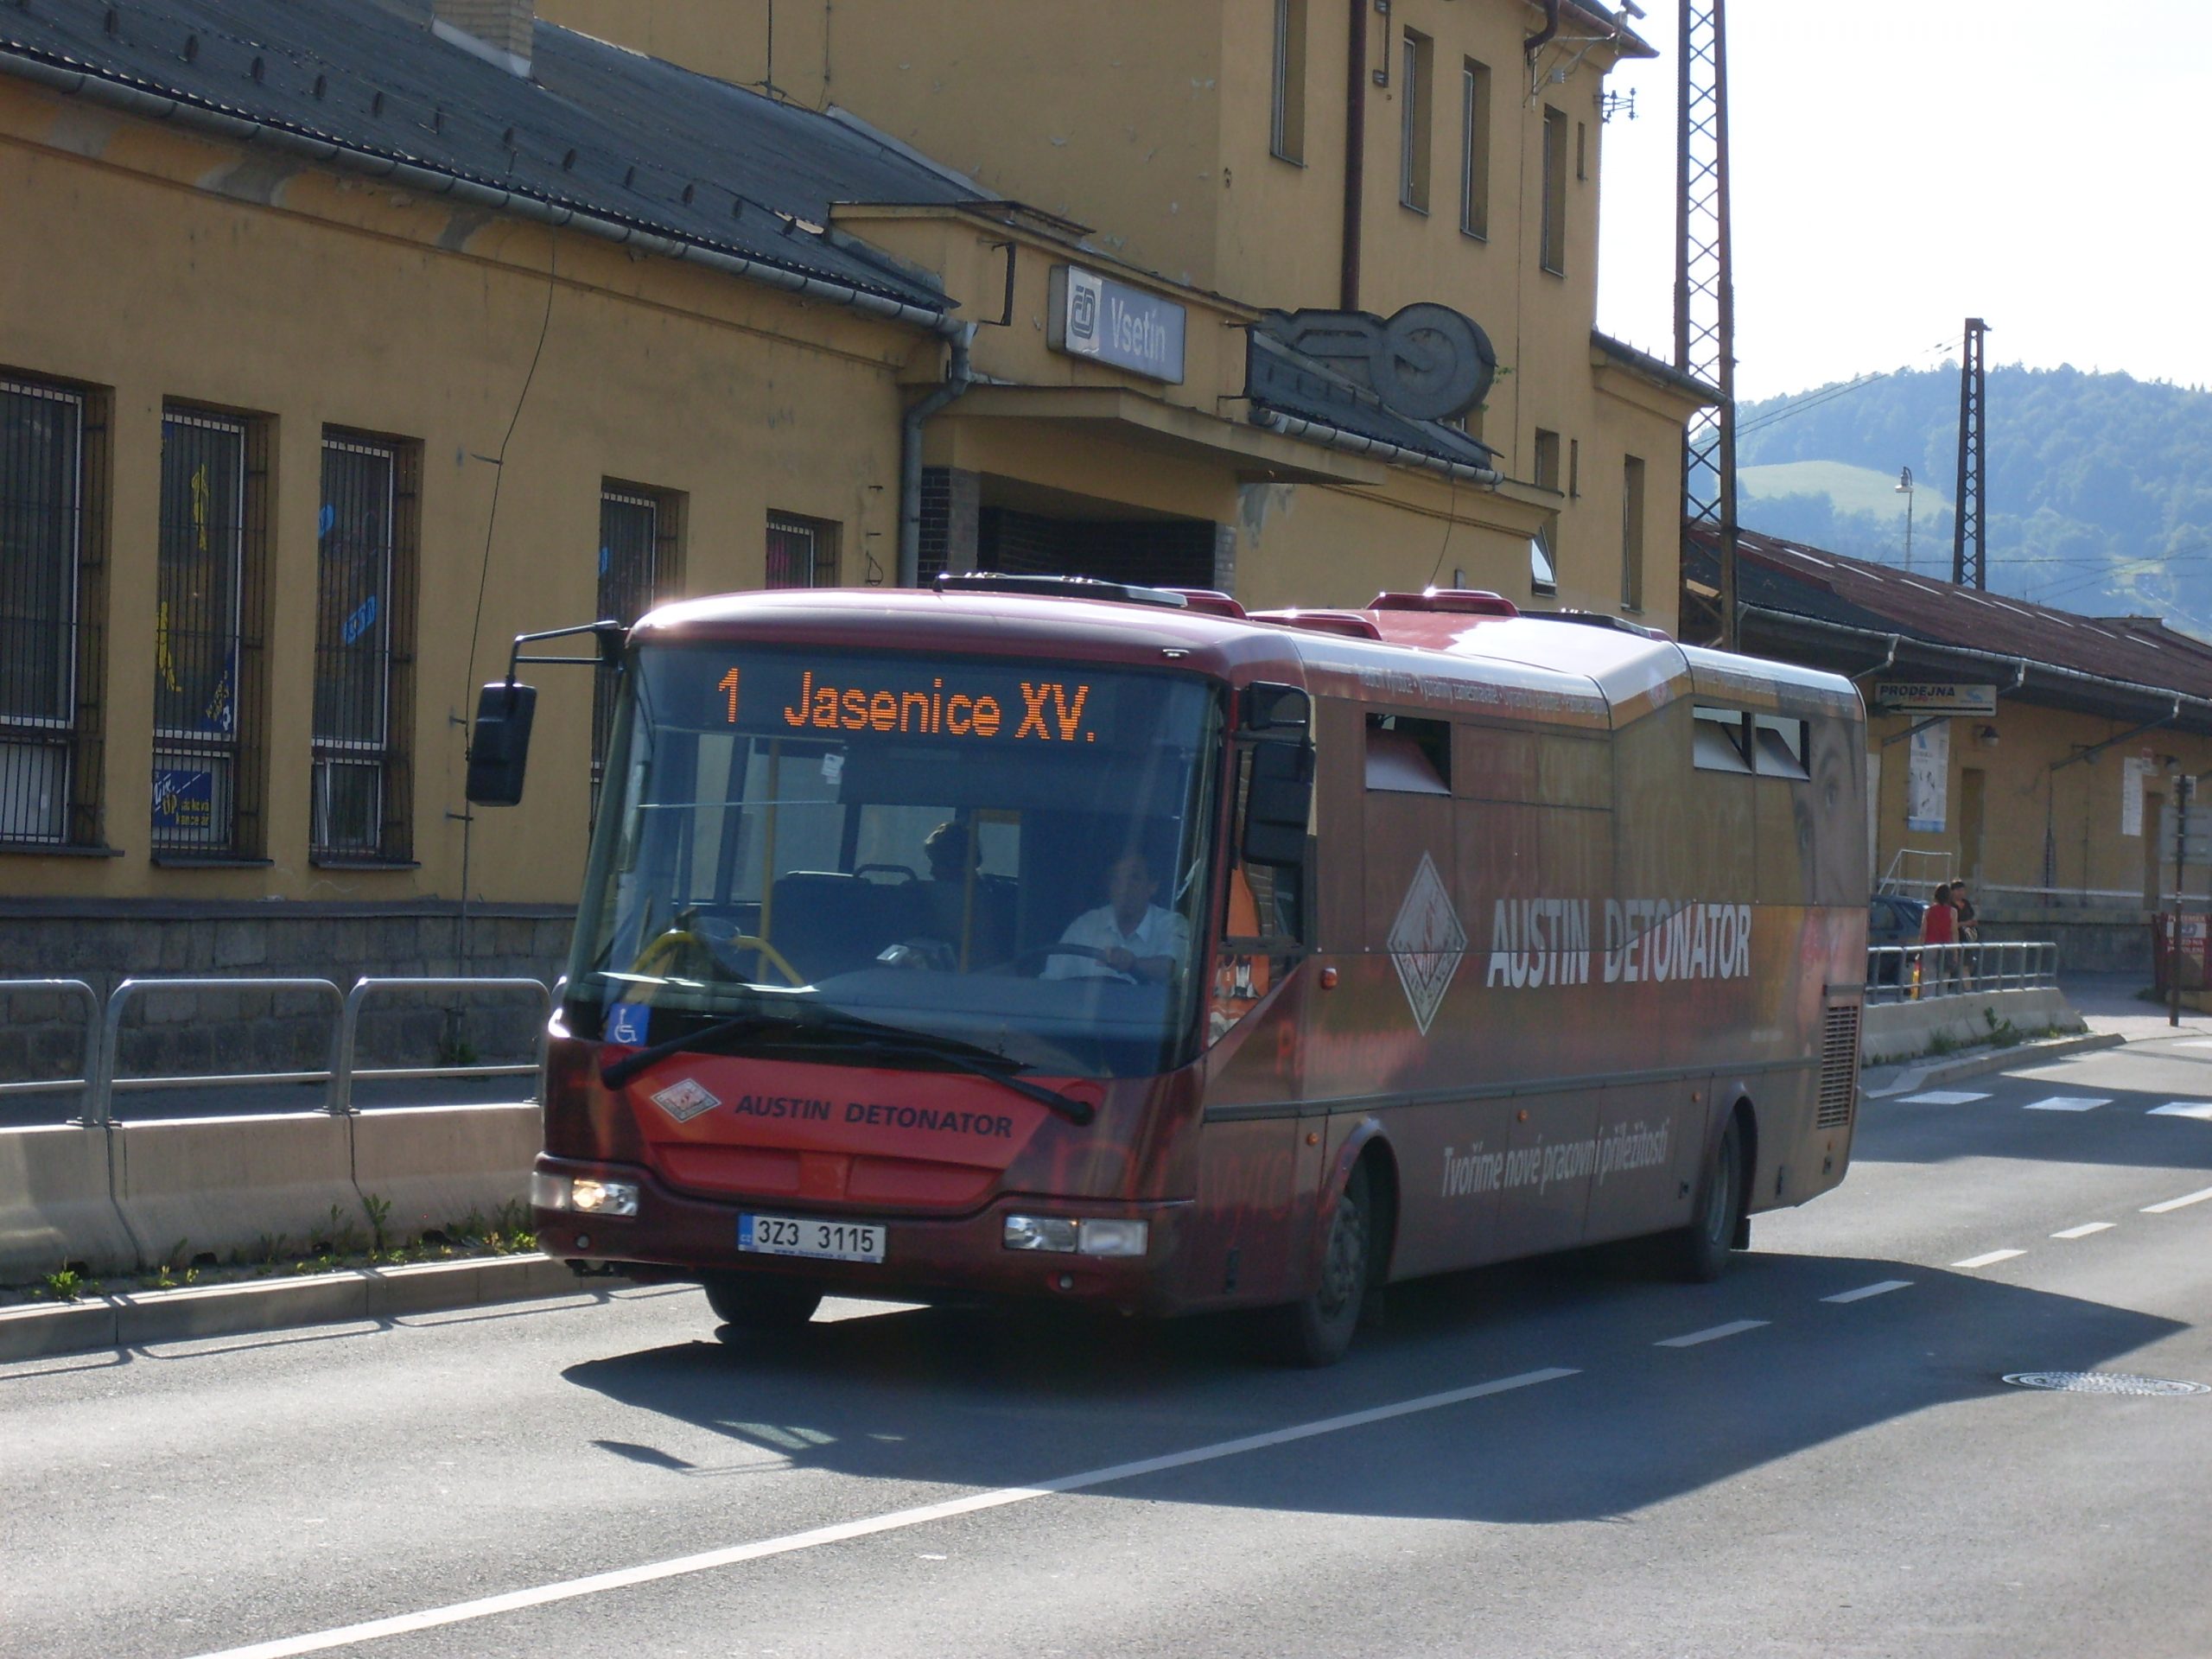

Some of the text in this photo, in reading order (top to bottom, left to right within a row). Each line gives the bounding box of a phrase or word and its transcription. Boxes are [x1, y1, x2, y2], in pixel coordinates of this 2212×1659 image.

[1111, 296, 1166, 362] Vsetín
[718, 667, 1096, 742] 1 Jasenice XV.
[1879, 685, 1955, 696] PRODEJNA
[1486, 899, 1590, 988] AUSTIN
[1604, 899, 1751, 983] DETONATOR
[735, 1095, 1013, 1138] AUSTIN DETONATOR
[1503, 1133, 1542, 1189] nové
[759, 1220, 874, 1253] 3Z3 3115
